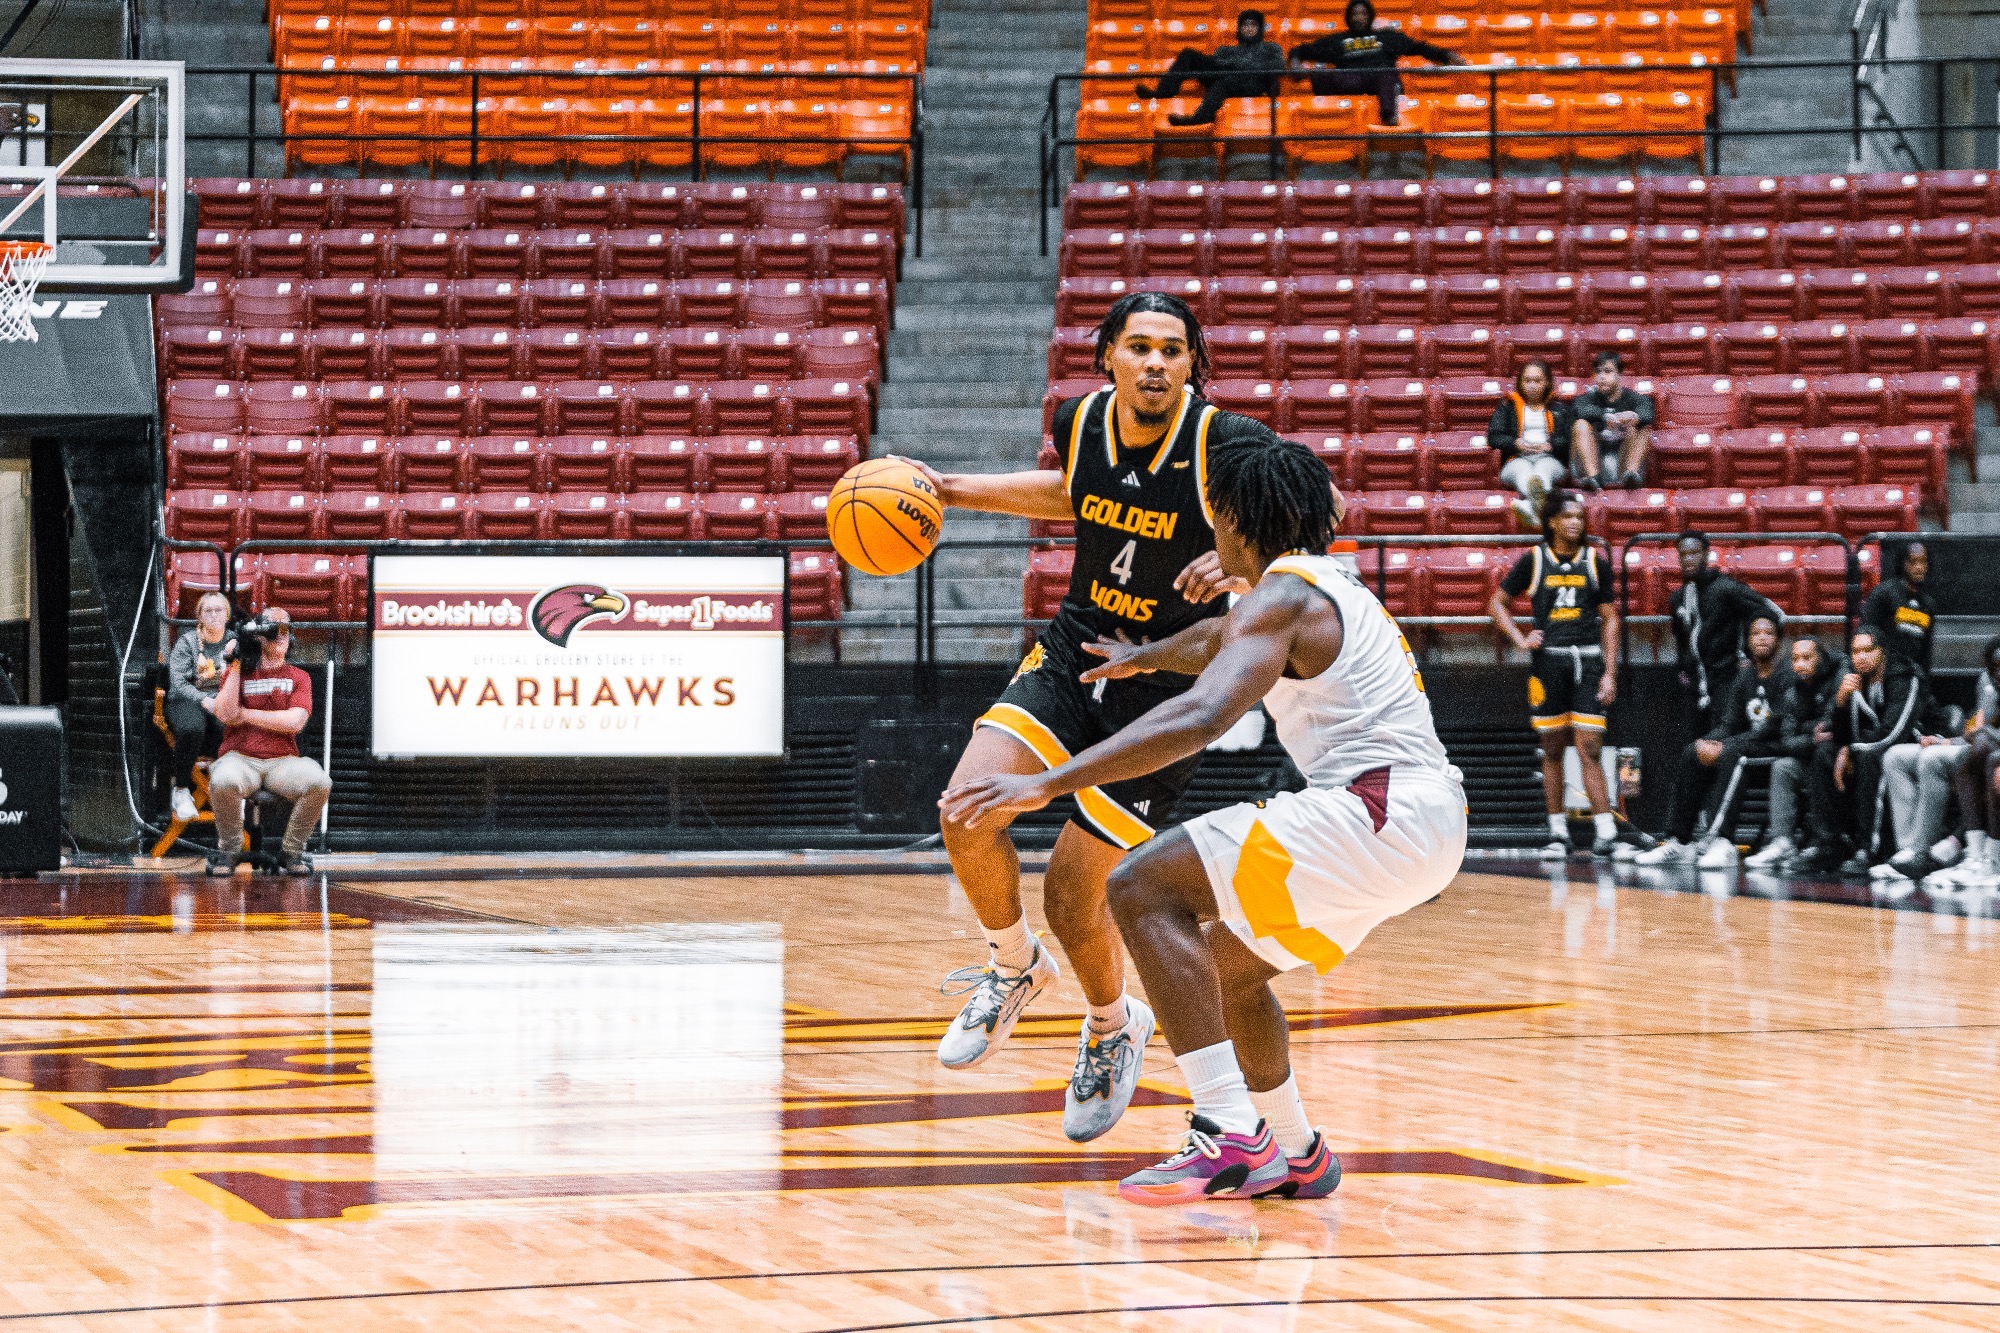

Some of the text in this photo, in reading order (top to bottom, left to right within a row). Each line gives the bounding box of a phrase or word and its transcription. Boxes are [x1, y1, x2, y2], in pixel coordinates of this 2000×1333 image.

[1081, 494, 1178, 539] GOLDEN
[1110, 540, 1136, 585] 4
[382, 599, 522, 626] Brookshire's
[634, 600, 693, 626] Super
[711, 601, 772, 622] Foods
[474, 654, 528, 666] OFFICIAL
[536, 654, 589, 666] GROCERY
[597, 654, 634, 666] STORE
[662, 654, 685, 666] THE
[426, 676, 737, 707] WARHAWKS
[502, 715, 642, 730] TALONS OUT
